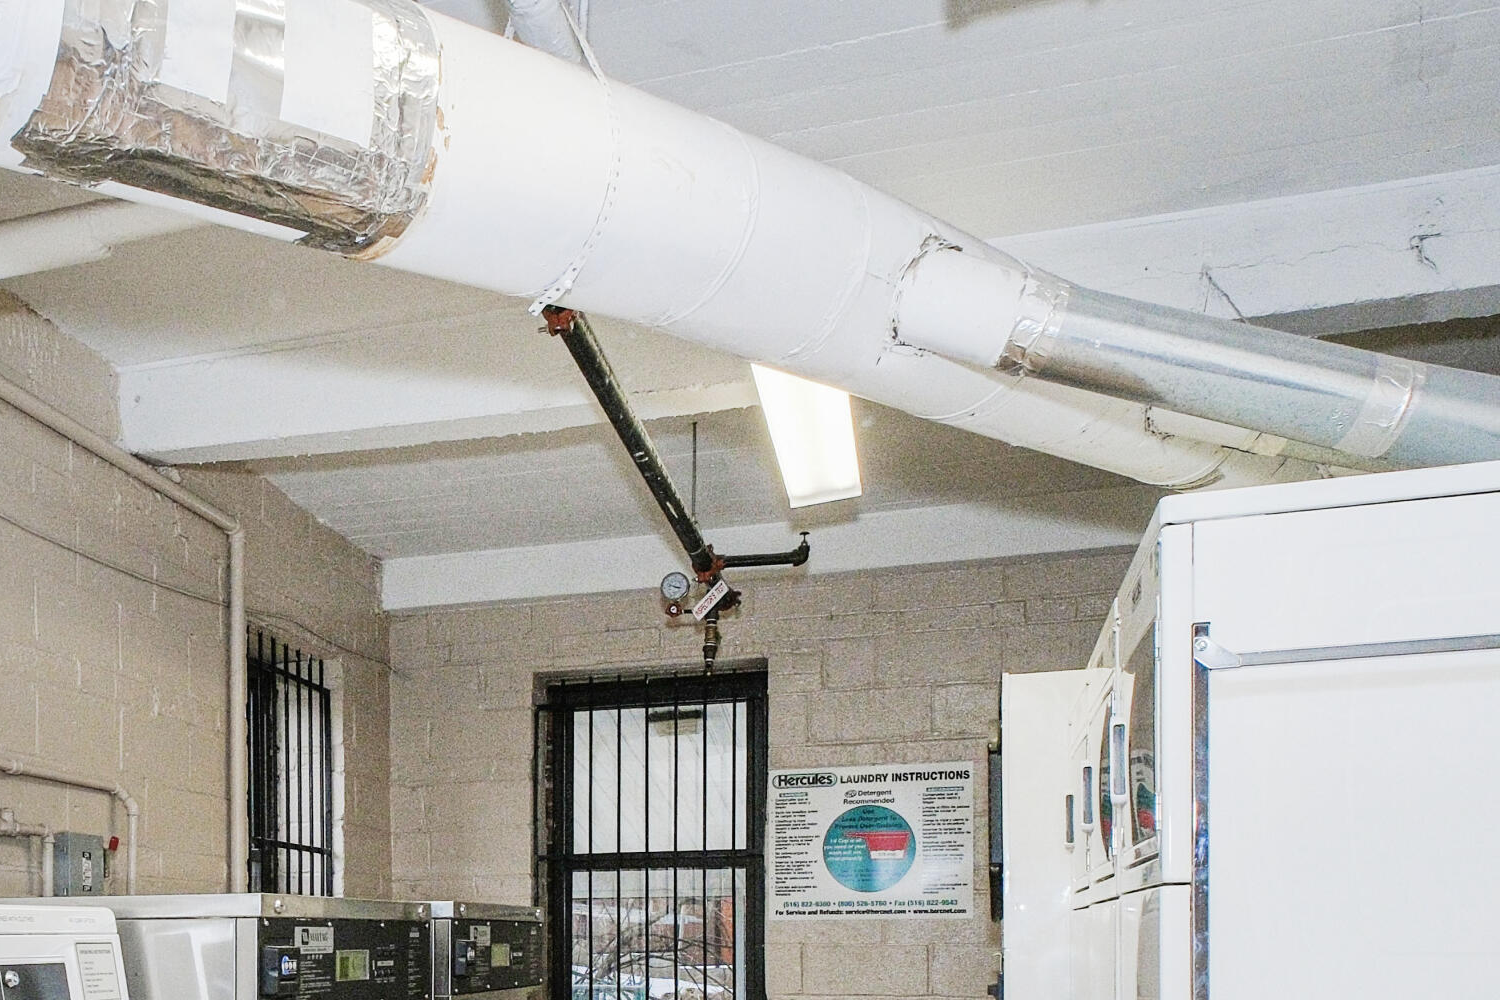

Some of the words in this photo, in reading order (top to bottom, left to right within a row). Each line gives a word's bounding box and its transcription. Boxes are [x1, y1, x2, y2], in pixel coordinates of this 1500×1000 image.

[778, 774, 833, 786] Hercules
[840, 774, 888, 784] LAUNDRY
[891, 770, 970, 782] INSTRUCTIONS
[844, 797, 894, 805] Recommended
